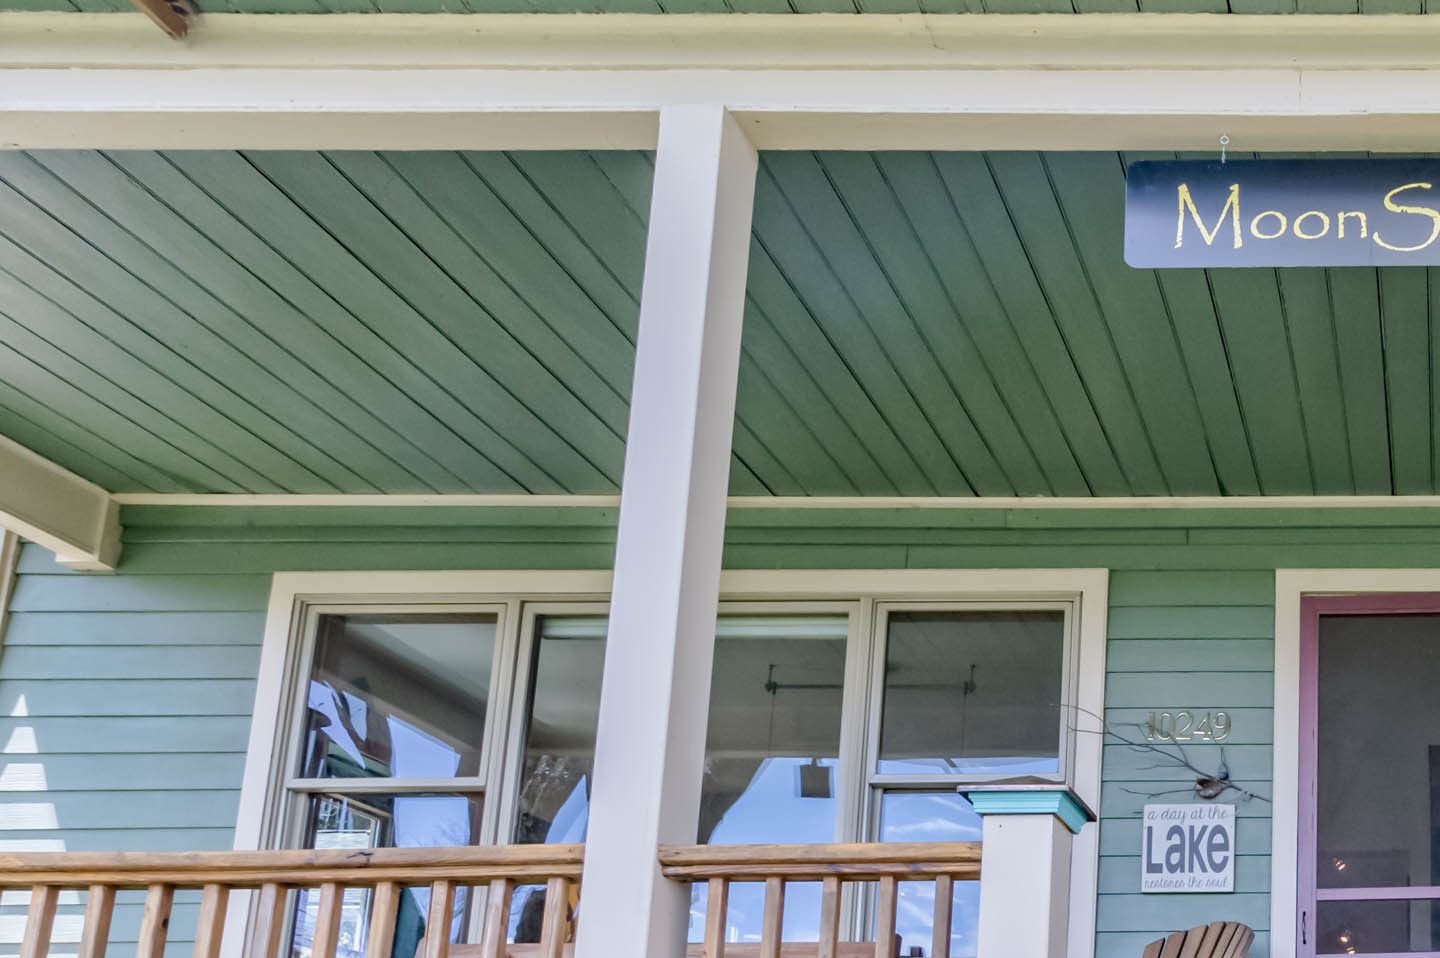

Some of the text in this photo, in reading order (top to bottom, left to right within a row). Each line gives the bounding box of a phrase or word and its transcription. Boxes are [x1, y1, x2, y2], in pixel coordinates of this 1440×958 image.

[1147, 711, 1232, 741] 10249
[1161, 808, 1186, 824] day
[1190, 808, 1204, 820] at
[1208, 805, 1227, 820] the
